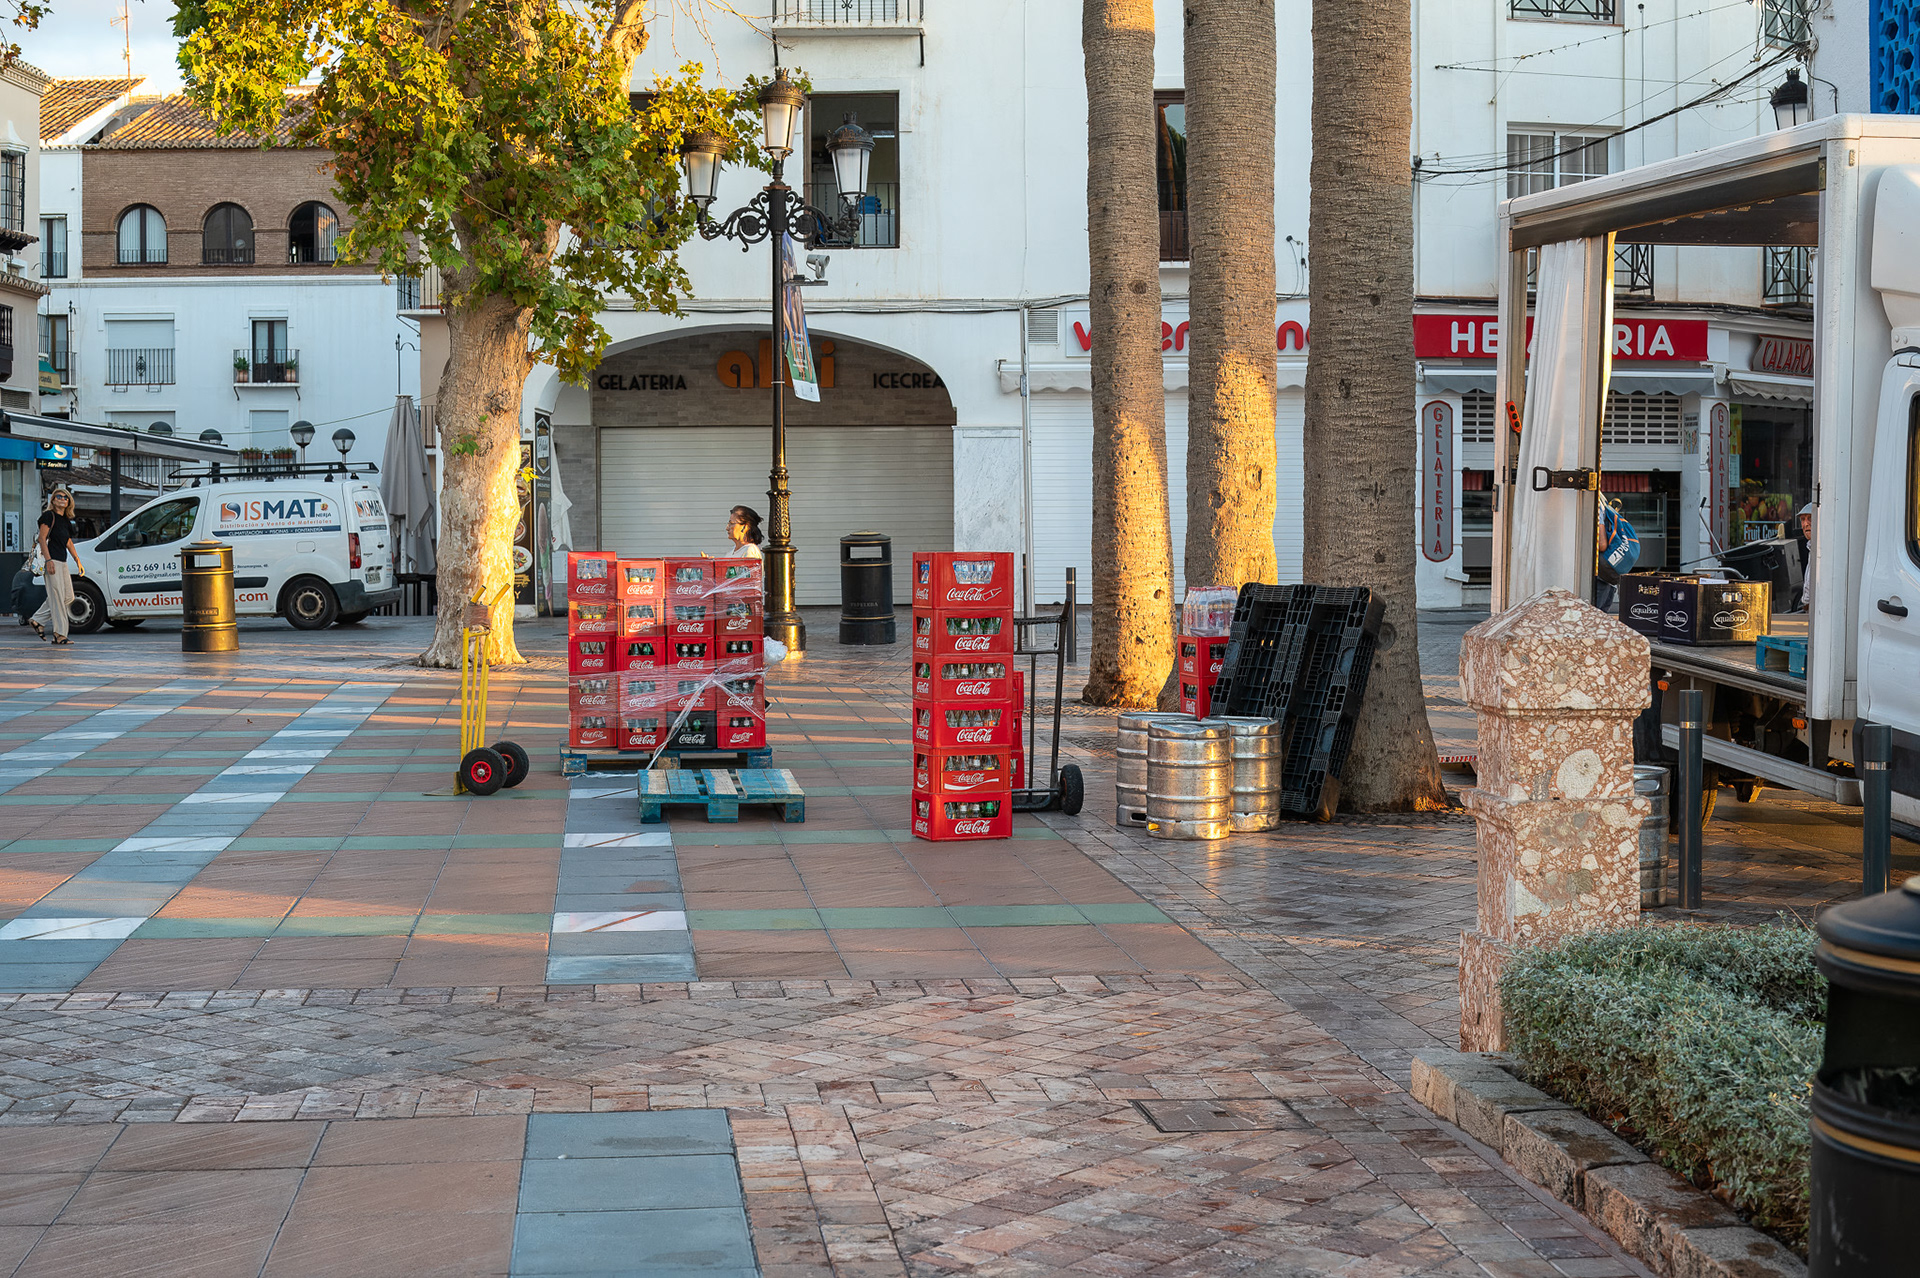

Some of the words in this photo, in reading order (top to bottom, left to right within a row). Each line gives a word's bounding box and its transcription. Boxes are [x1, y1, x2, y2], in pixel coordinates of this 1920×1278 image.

[1451, 321, 1675, 356] HERIA
[597, 375, 686, 391] GELATERIA
[1433, 407, 1443, 555] GELATERIA
[1743, 524, 1761, 540] Fruit
[126, 564, 141, 572] 652
[143, 563, 159, 572] 669
[162, 562, 177, 570] 143
[946, 587, 985, 601] Coca-Cola
[955, 636, 991, 651] Coca-Cola
[956, 681, 991, 695] Coca-Cola
[956, 728, 993, 743] Coca-Cola
[954, 820, 991, 834] Coca-Cola
